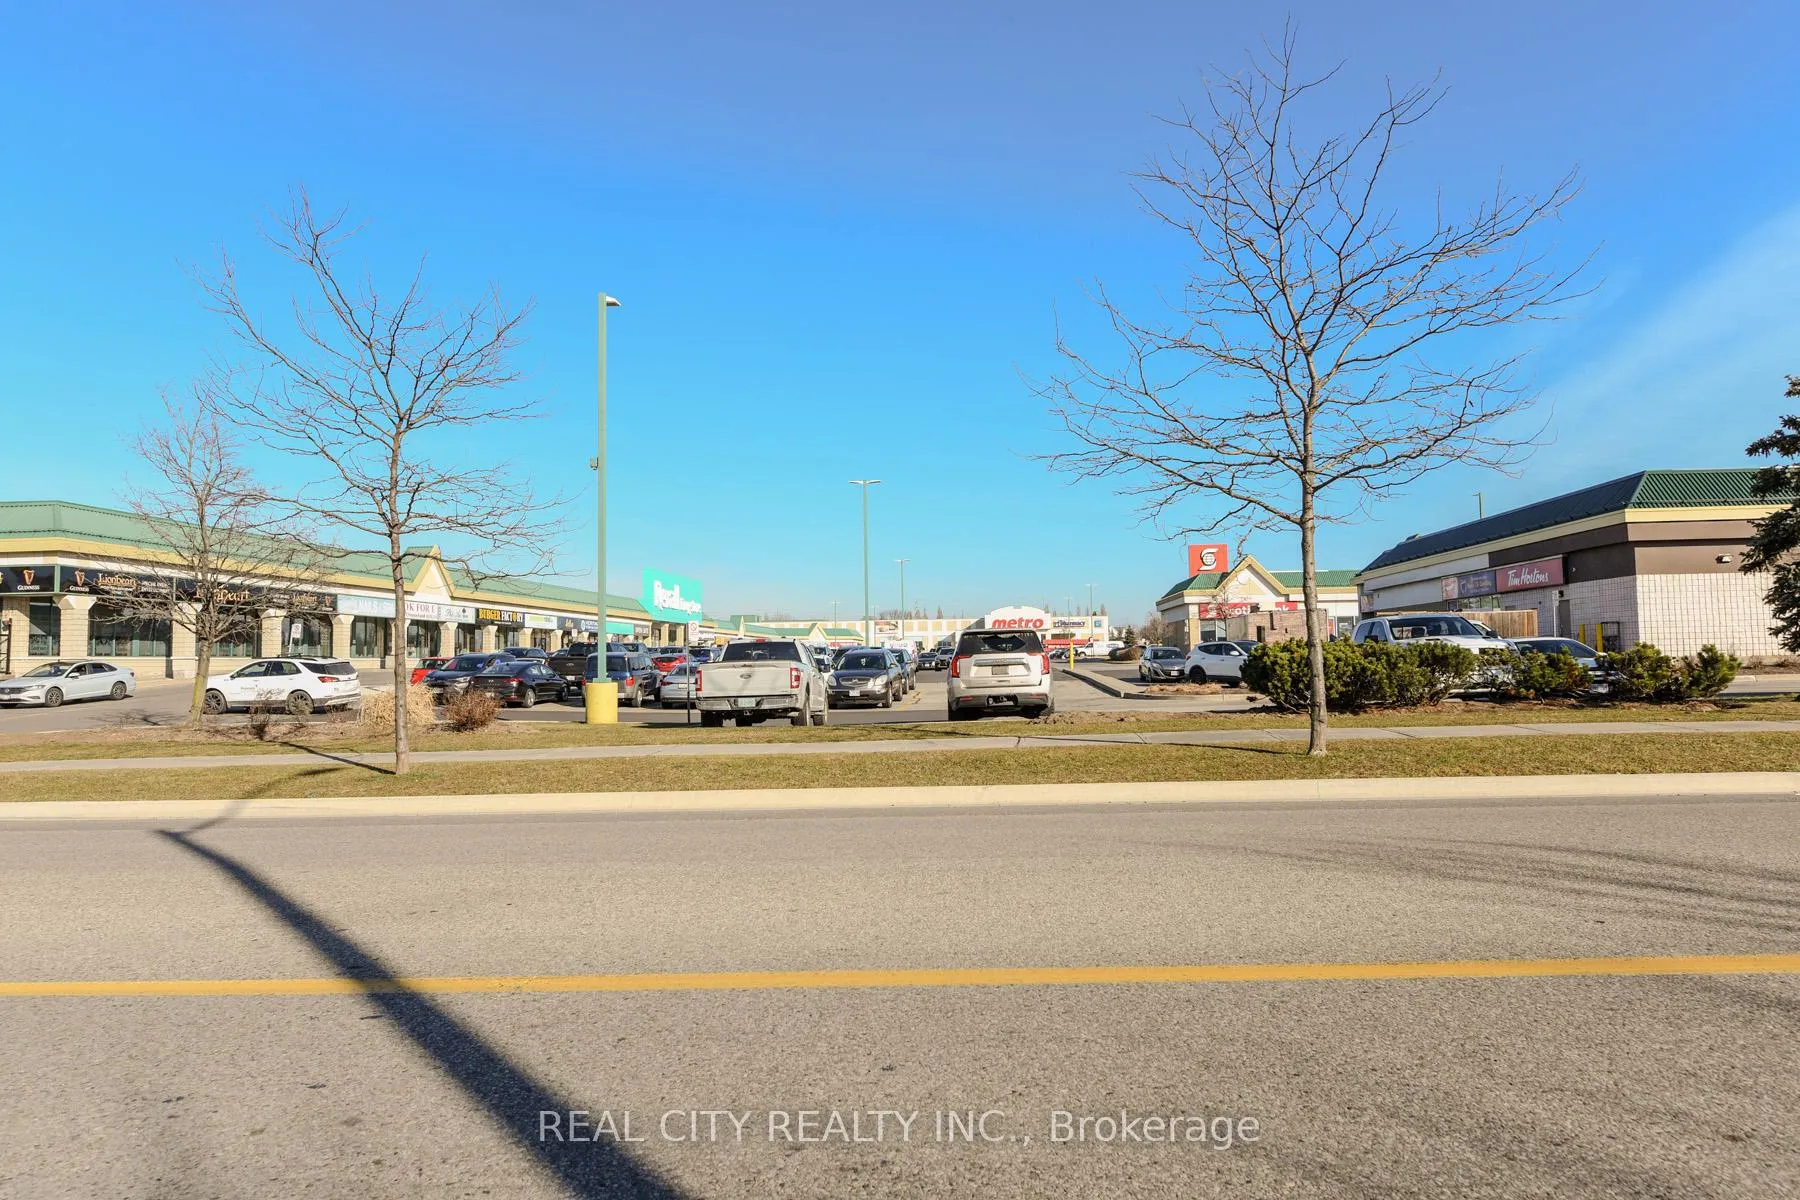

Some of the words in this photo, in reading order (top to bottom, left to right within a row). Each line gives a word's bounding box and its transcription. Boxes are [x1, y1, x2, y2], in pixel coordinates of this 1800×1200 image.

[1508, 569, 1520, 587] Tim
[1520, 568, 1549, 585] Hortons
[479, 608, 501, 621] BURGER
[501, 610, 523, 623] FACTORY
[992, 617, 1044, 629] metro
